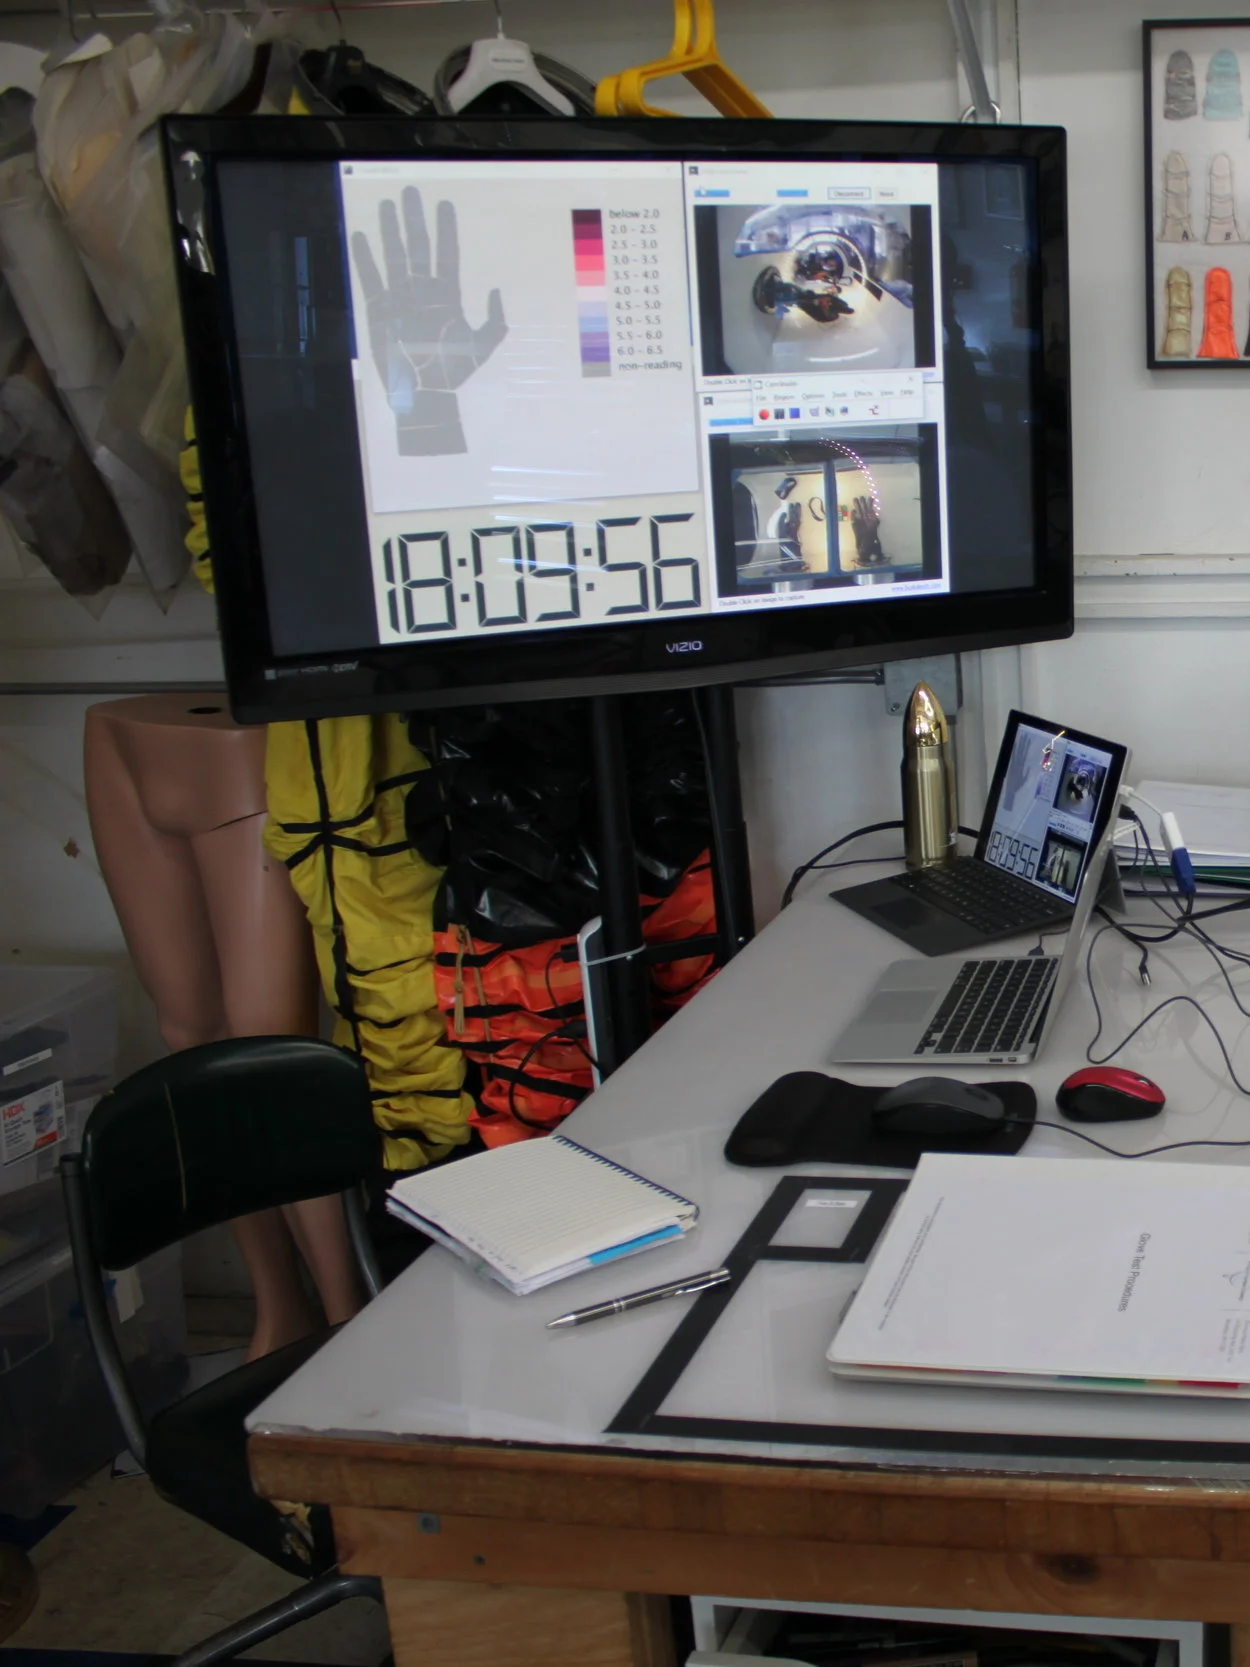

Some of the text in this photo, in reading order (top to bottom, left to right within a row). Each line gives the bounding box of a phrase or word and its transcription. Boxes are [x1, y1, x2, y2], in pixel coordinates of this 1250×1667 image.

[609, 208, 660, 218] below 2.0
[610, 225, 627, 234] 2.0
[640, 224, 656, 233] 2.5
[1181, 231, 1188, 241] A
[611, 240, 628, 249] 2.5
[641, 240, 657, 248] 3.0
[612, 256, 629, 265] 3.0
[642, 256, 658, 264] 3.5
[613, 271, 629, 280] 3.5
[642, 270, 659, 279] 4.0
[614, 286, 631, 295] 4.0
[643, 286, 660, 294] 4.5
[615, 301, 632, 310] 4.5
[644, 301, 661, 309] 5.0
[616, 316, 632, 325] 5.0
[616, 332, 633, 340] 5.5
[646, 331, 662, 340] 6.0
[617, 347, 634, 355] 6.0
[647, 346, 663, 354] 6.5
[618, 360, 682, 371] non-reading
[383, 513, 701, 634] 18:09:56
[665, 640, 702, 654] VIZIO
[1118, 1232, 1151, 1312] Glove Test Procedures
